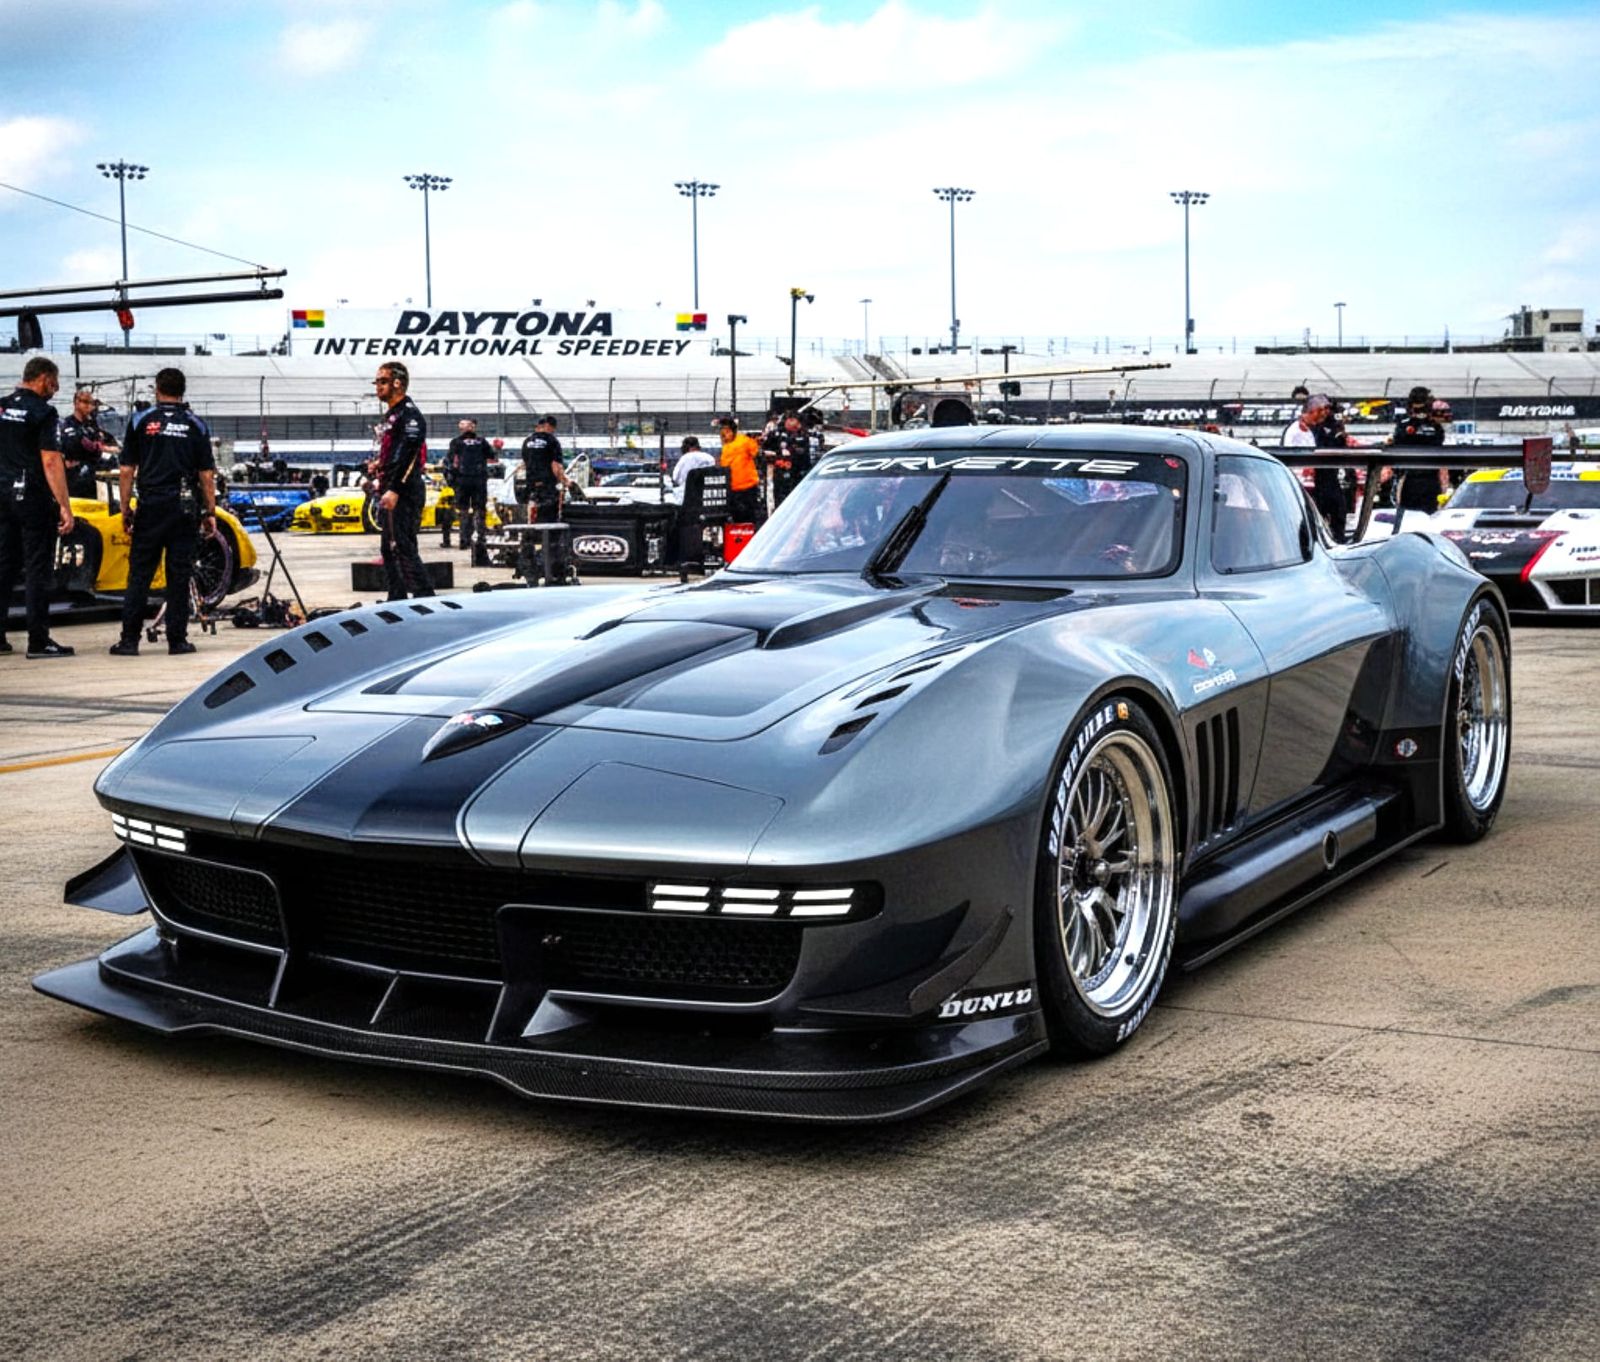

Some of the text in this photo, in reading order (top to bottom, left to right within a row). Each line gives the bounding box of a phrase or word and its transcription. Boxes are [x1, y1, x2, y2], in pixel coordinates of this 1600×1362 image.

[395, 310, 612, 336] DAYTONA
[313, 338, 691, 356] INTERNATIONAL SPEEDEEY
[818, 456, 1139, 474] CORVETTE
